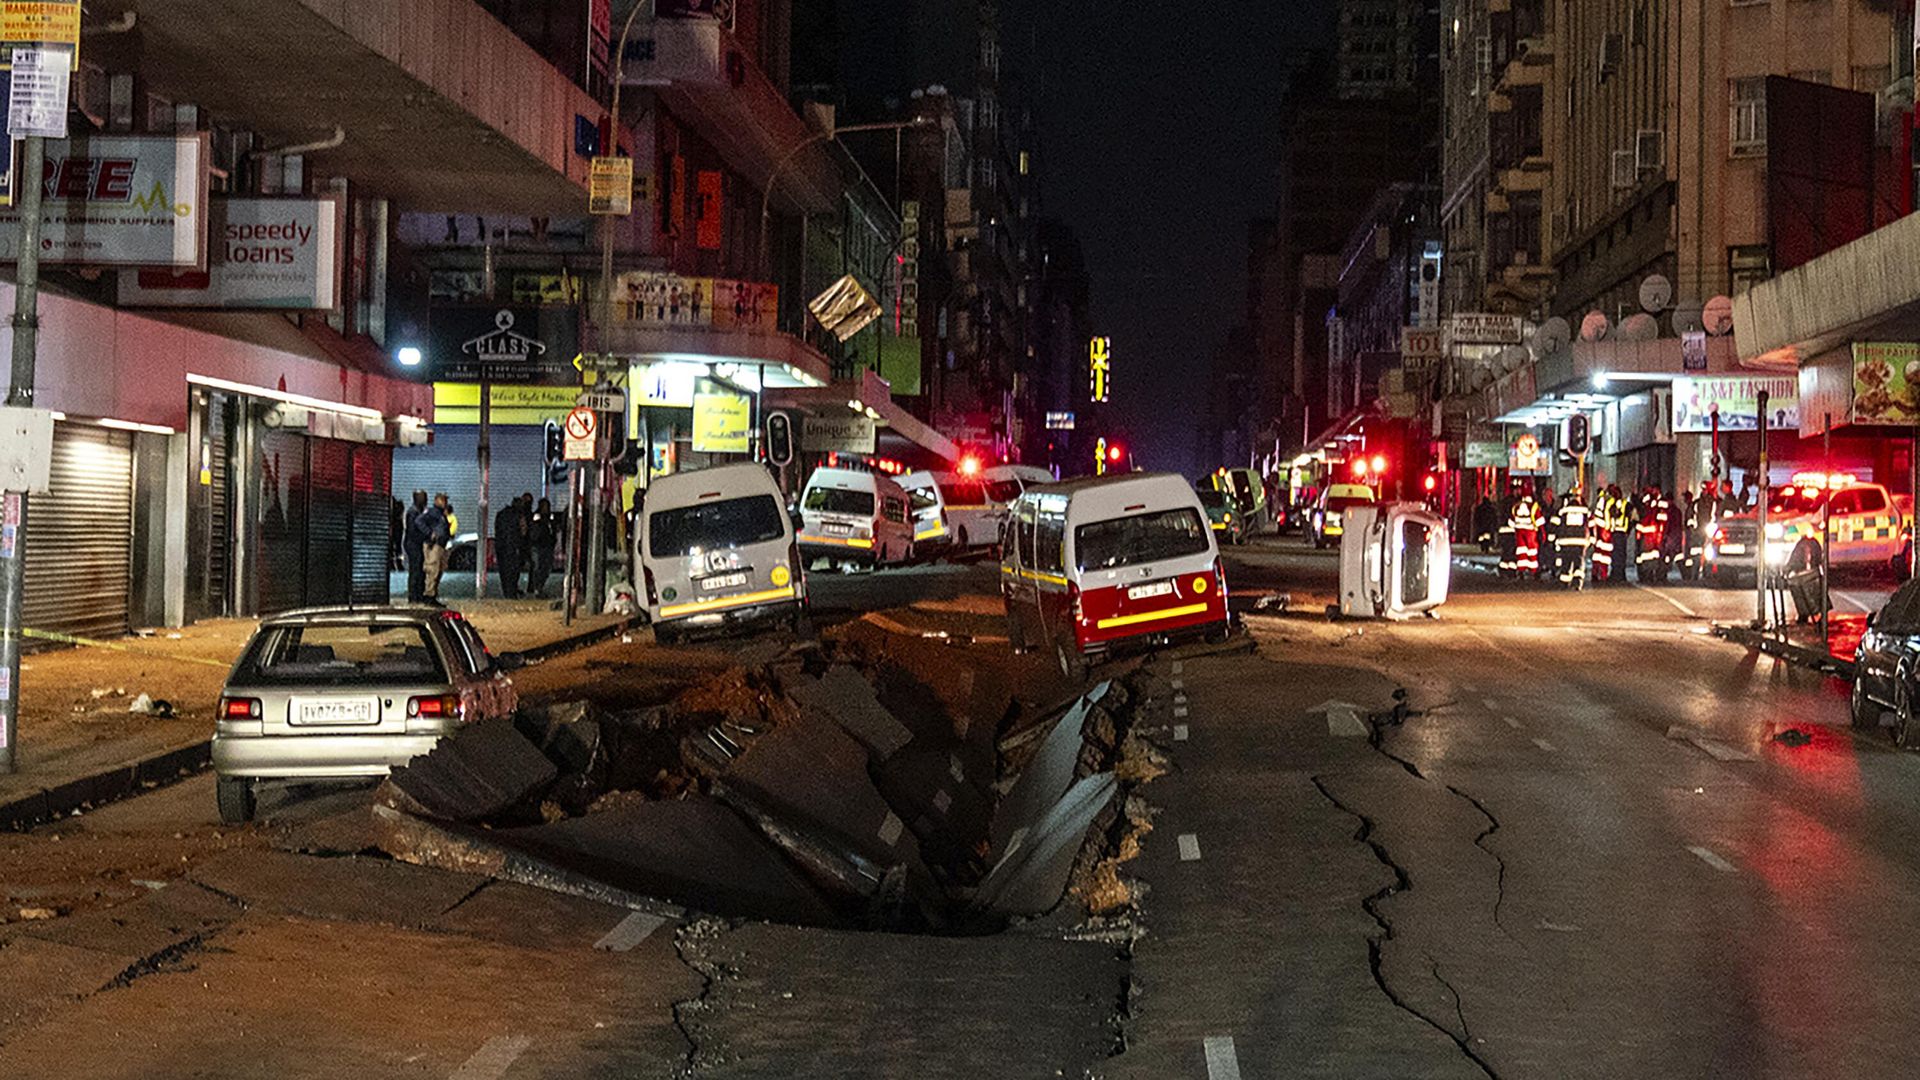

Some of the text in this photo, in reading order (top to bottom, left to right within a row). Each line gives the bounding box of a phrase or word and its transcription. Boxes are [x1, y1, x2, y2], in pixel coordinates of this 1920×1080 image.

[5, 4, 75, 15] MANAGEMENT
[42, 157, 137, 202] REE
[225, 219, 311, 246] speedy
[225, 242, 295, 264] loans
[476, 338, 530, 354] CLASS
[1739, 379, 1795, 400] FASHION
[588, 396, 610, 408] IBIS
[806, 423, 851, 441] Unique
